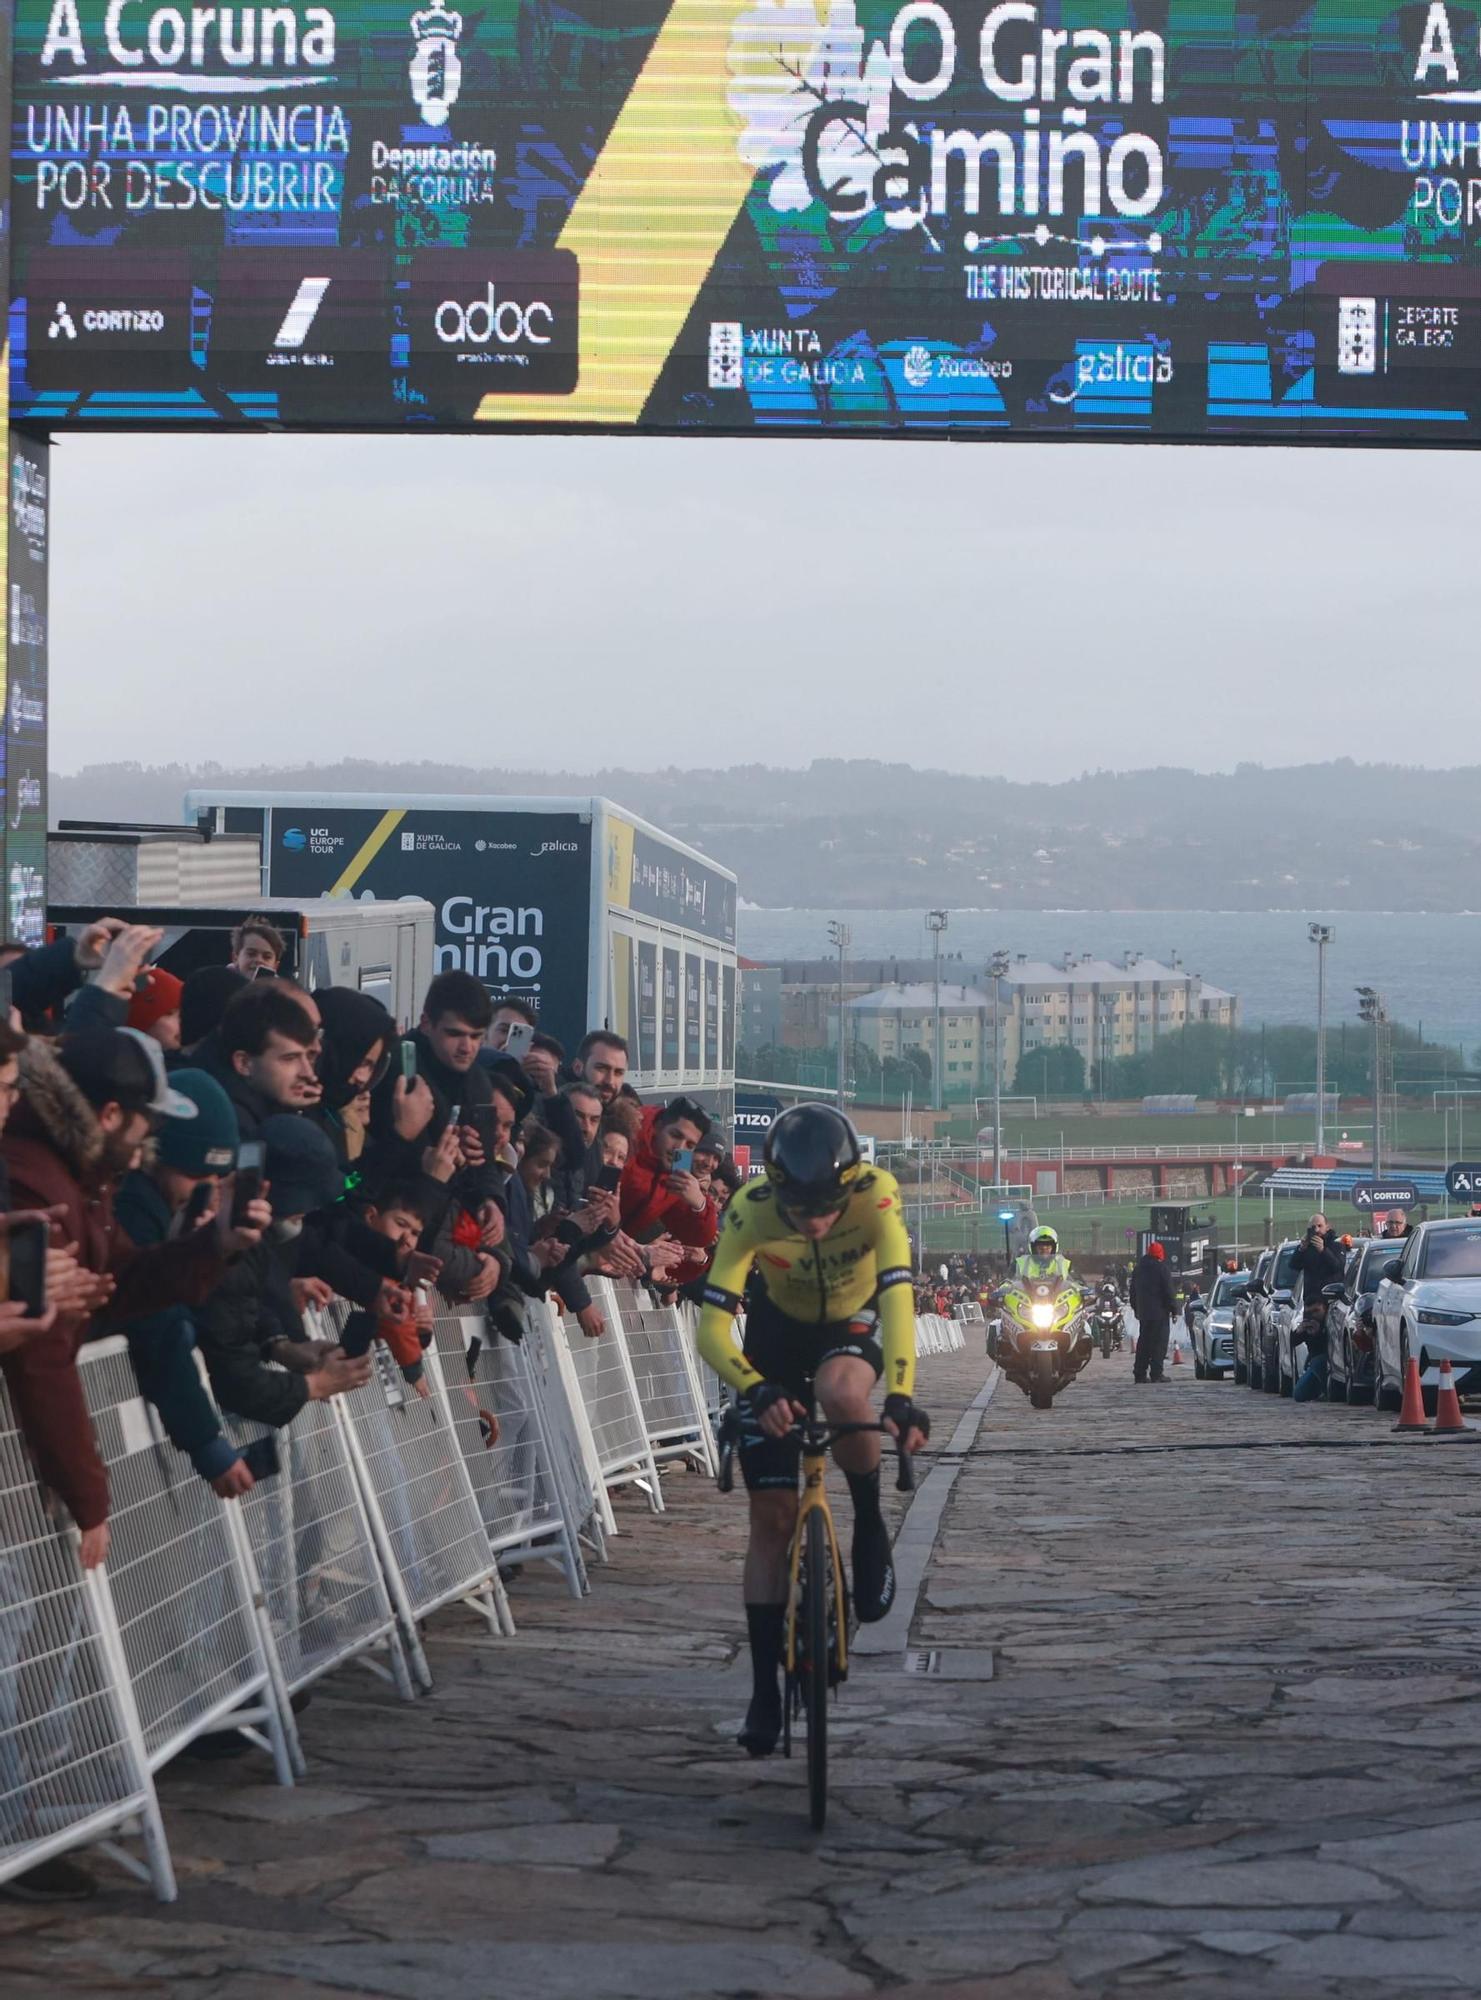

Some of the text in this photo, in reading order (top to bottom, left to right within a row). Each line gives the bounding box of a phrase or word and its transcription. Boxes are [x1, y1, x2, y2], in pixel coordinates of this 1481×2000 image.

[41, 0, 87, 66] A
[1414, 2, 1459, 83] A
[889, 2, 1165, 104] O Gran
[28, 105, 349, 153] UNHA PROVINCIA
[802, 100, 1163, 217] Camiño
[36, 160, 337, 210] POR DESCUBRIR
[964, 265, 995, 299] THE
[1001, 266, 1103, 300] HISTORICAL
[435, 281, 553, 343] adoc
[750, 329, 821, 354] XUNTA
[749, 360, 865, 384] DE GALICIA
[1050, 345, 1173, 404] galicia
[310, 828, 328, 836] UCI
[310, 837, 344, 845] EUROPE
[416, 842, 461, 851] DE GALICIA
[417, 834, 445, 842] XUNTA
[488, 841, 518, 850] Xacobeo
[310, 845, 334, 854] TOUR
[530, 839, 578, 857] galicia
[441, 896, 544, 936] Gran
[1374, 1191, 1411, 1200] CORTIZO
